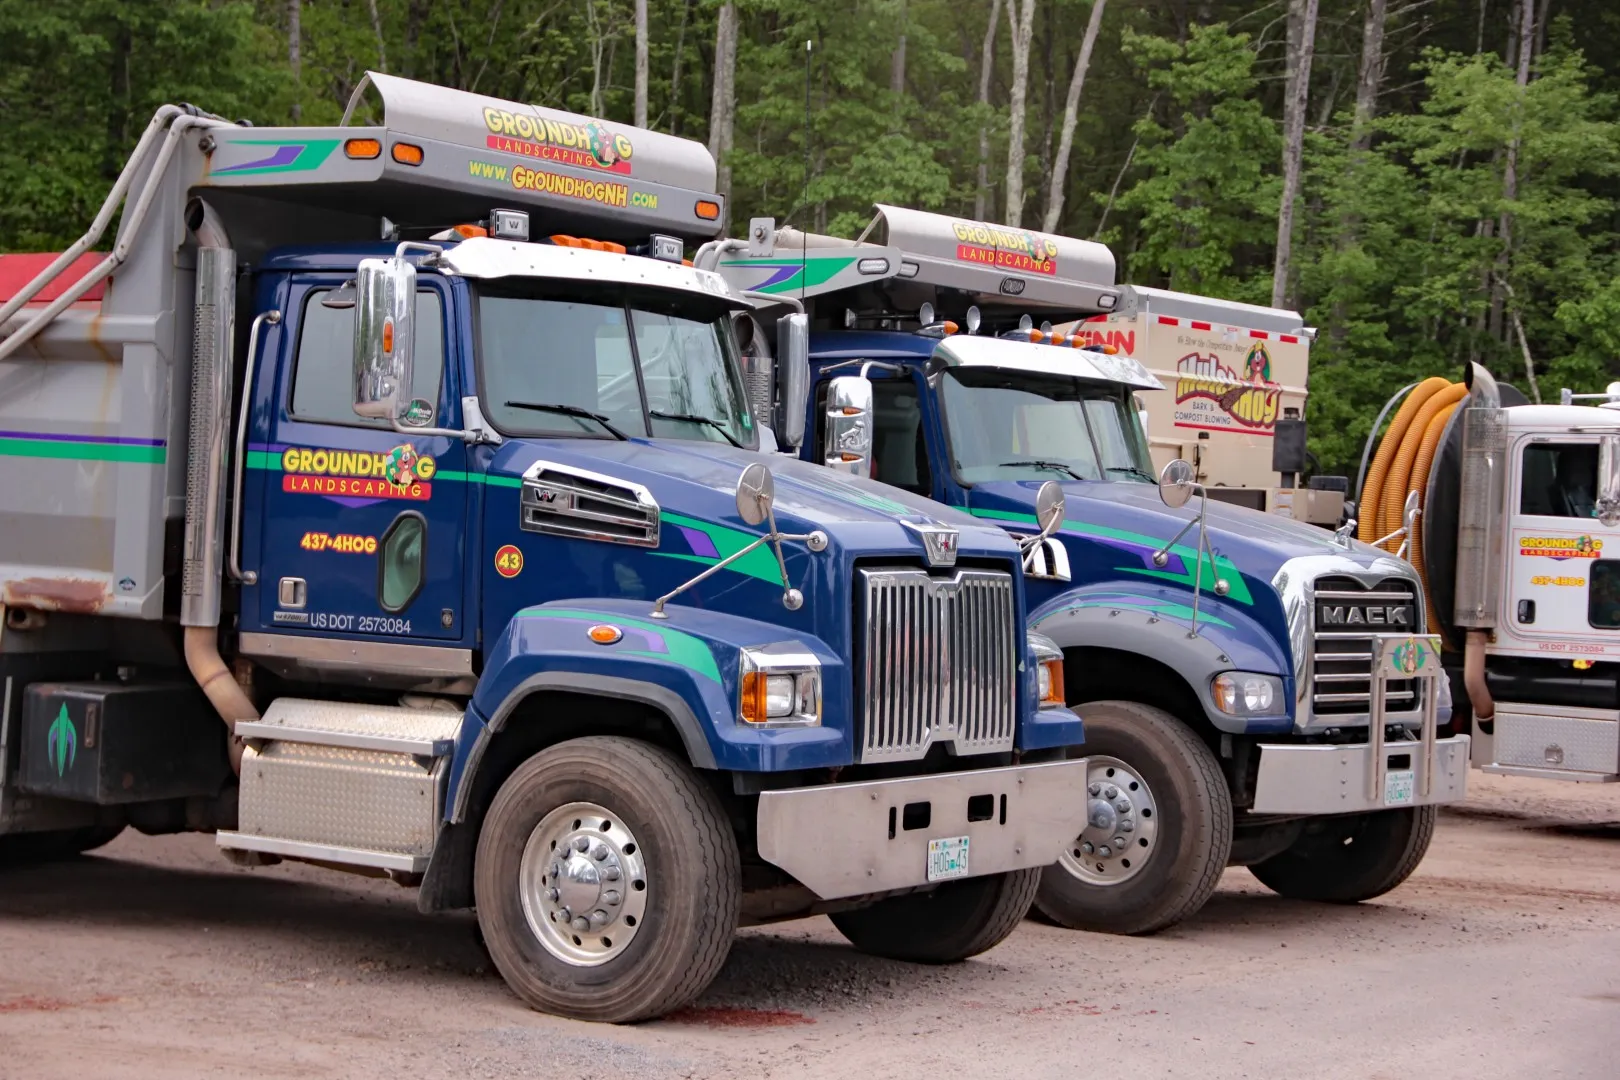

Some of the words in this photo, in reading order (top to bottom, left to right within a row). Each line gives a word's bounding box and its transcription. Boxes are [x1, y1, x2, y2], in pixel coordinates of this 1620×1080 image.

[496, 136, 593, 166] LANDSCAPING
[963, 246, 1051, 272] LANDSCAPING
[1193, 401, 1208, 411] BARK
[1174, 411, 1203, 422] COMPOST
[1205, 414, 1231, 425] BLOWING
[290, 476, 422, 497] LANDSCAPING
[498, 554, 520, 568] 43
[1523, 549, 1597, 557] LANDSCAPING
[310, 612, 327, 628] US
[329, 614, 355, 630] DOT
[358, 616, 411, 634] 2573084
[1322, 605, 1408, 625] MACK
[1551, 643, 1566, 651] DOT
